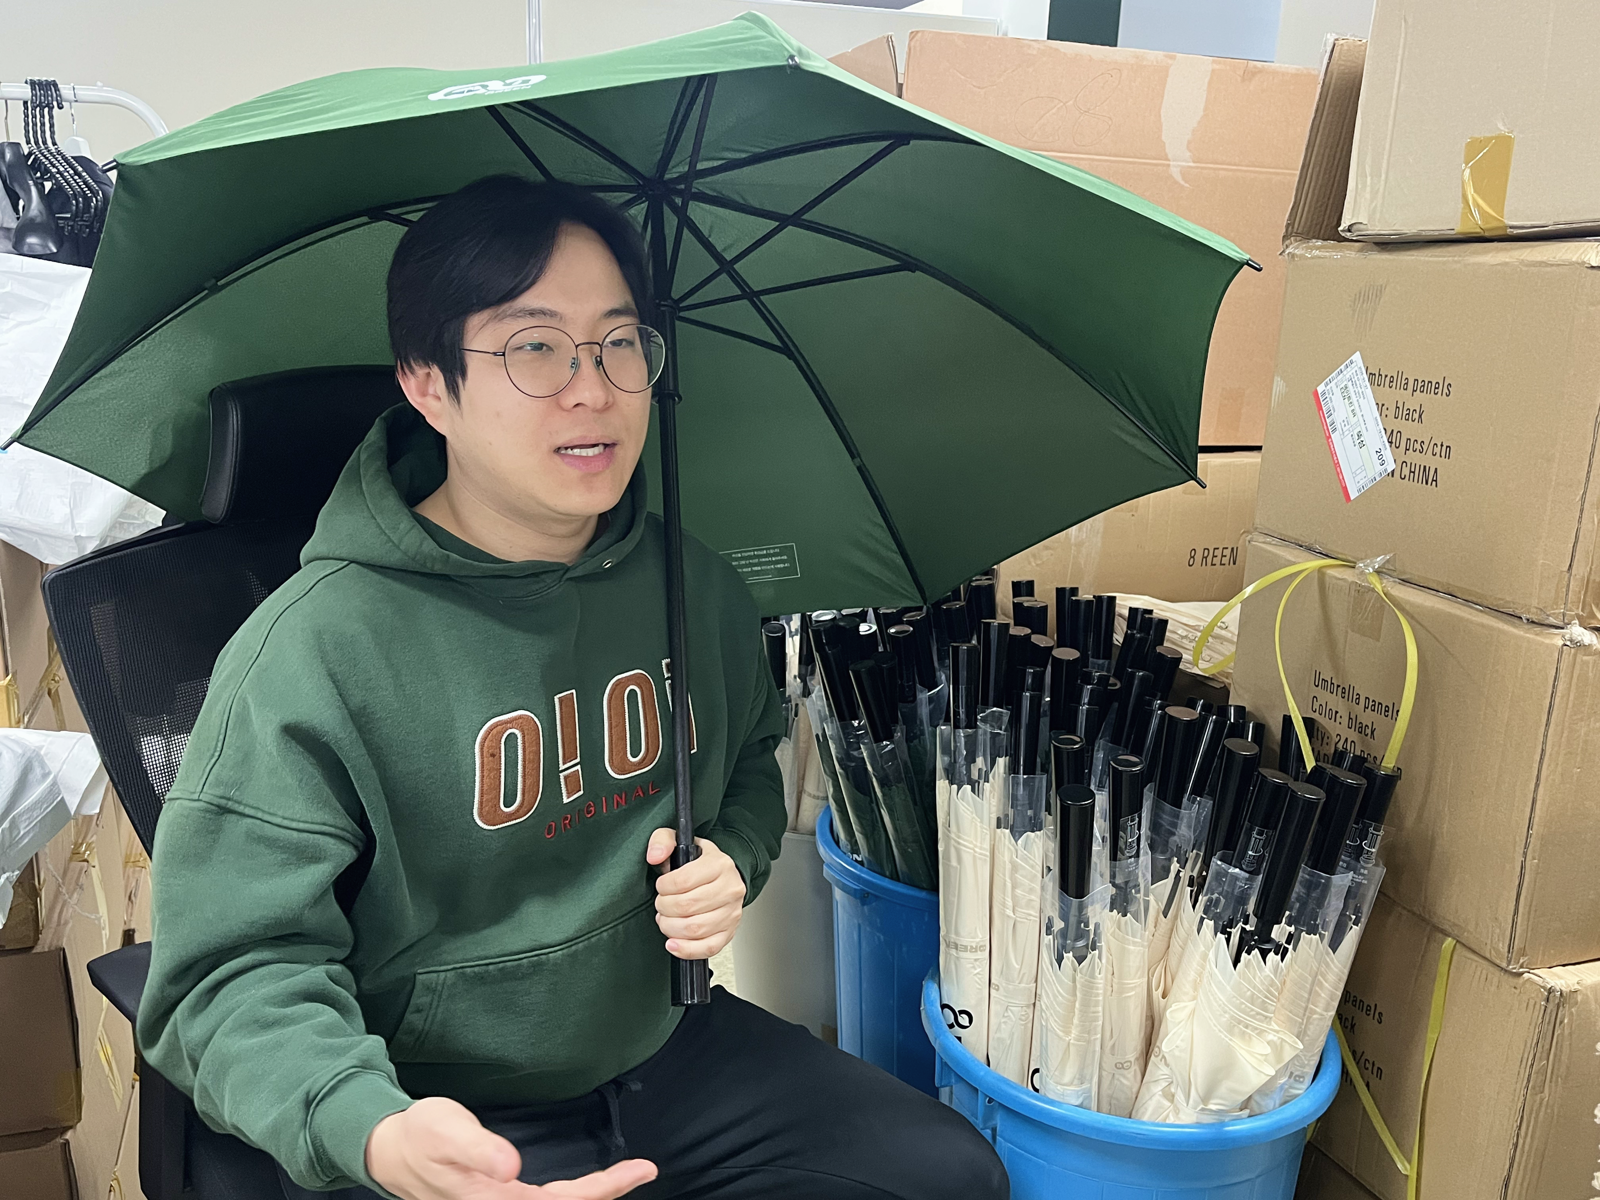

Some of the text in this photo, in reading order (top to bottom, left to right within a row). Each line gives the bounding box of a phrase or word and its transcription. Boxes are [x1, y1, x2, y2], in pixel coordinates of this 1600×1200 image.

[1412, 376, 1452, 398] panels
[1394, 400, 1424, 424] black
[1375, 448, 1386, 467] 209
[1404, 436, 1452, 460] pcs/ctn
[1400, 460, 1438, 488] CHINA
[1187, 546, 1239, 567] 8 REEN
[1313, 670, 1361, 706] Umbrella
[1311, 695, 1377, 741] Color: black
[1312, 726, 1330, 747] ty:
[544, 781, 661, 839] ORIGINAL
[1344, 989, 1384, 1024] panels
